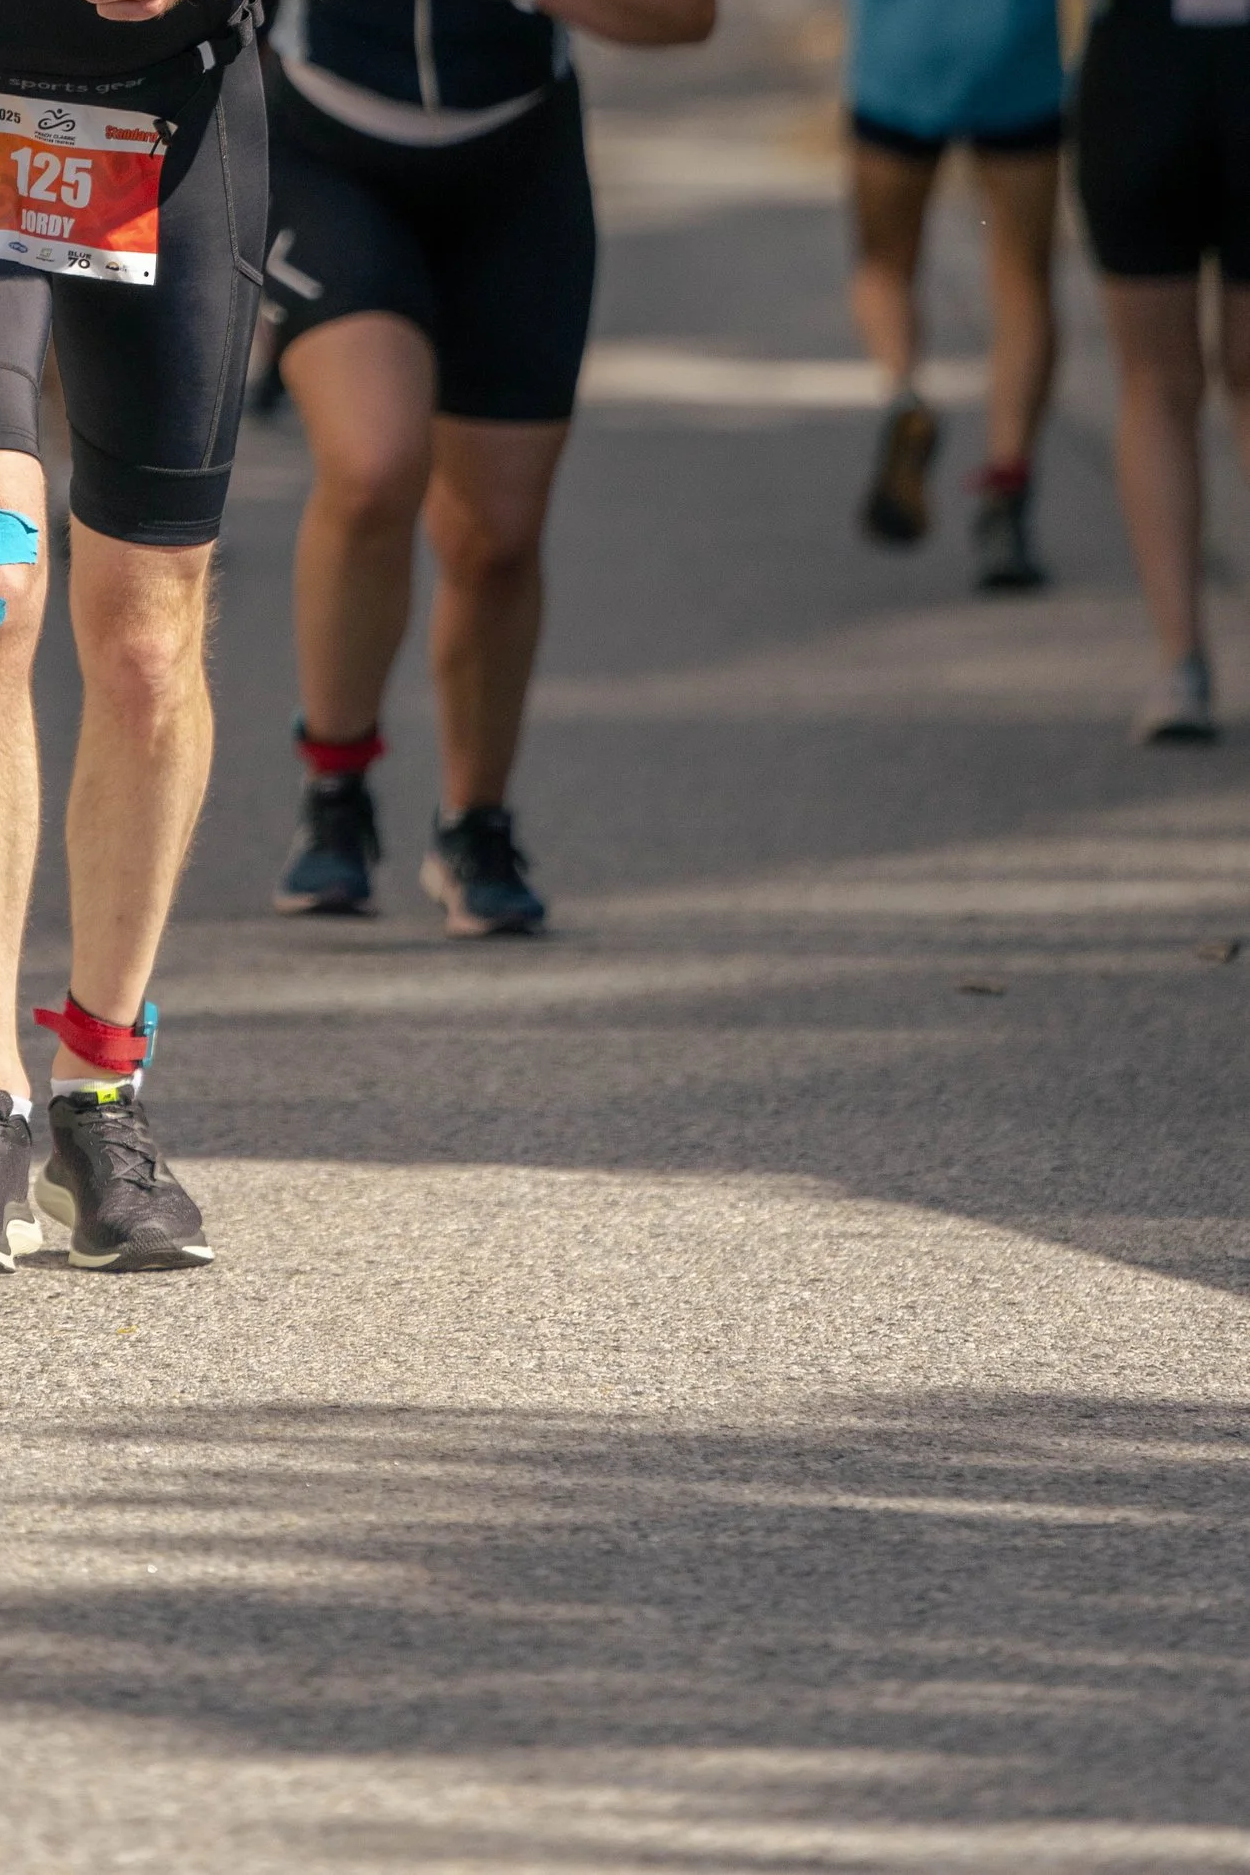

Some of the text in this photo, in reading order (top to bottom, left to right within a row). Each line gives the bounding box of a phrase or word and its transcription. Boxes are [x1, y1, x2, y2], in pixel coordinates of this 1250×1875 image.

[10, 77, 88, 93] sports
[95, 76, 146, 94] gear
[10, 147, 93, 209] 125
[21, 208, 76, 239] JORDY
[68, 250, 92, 260] BLUE
[68, 257, 91, 269] 70
